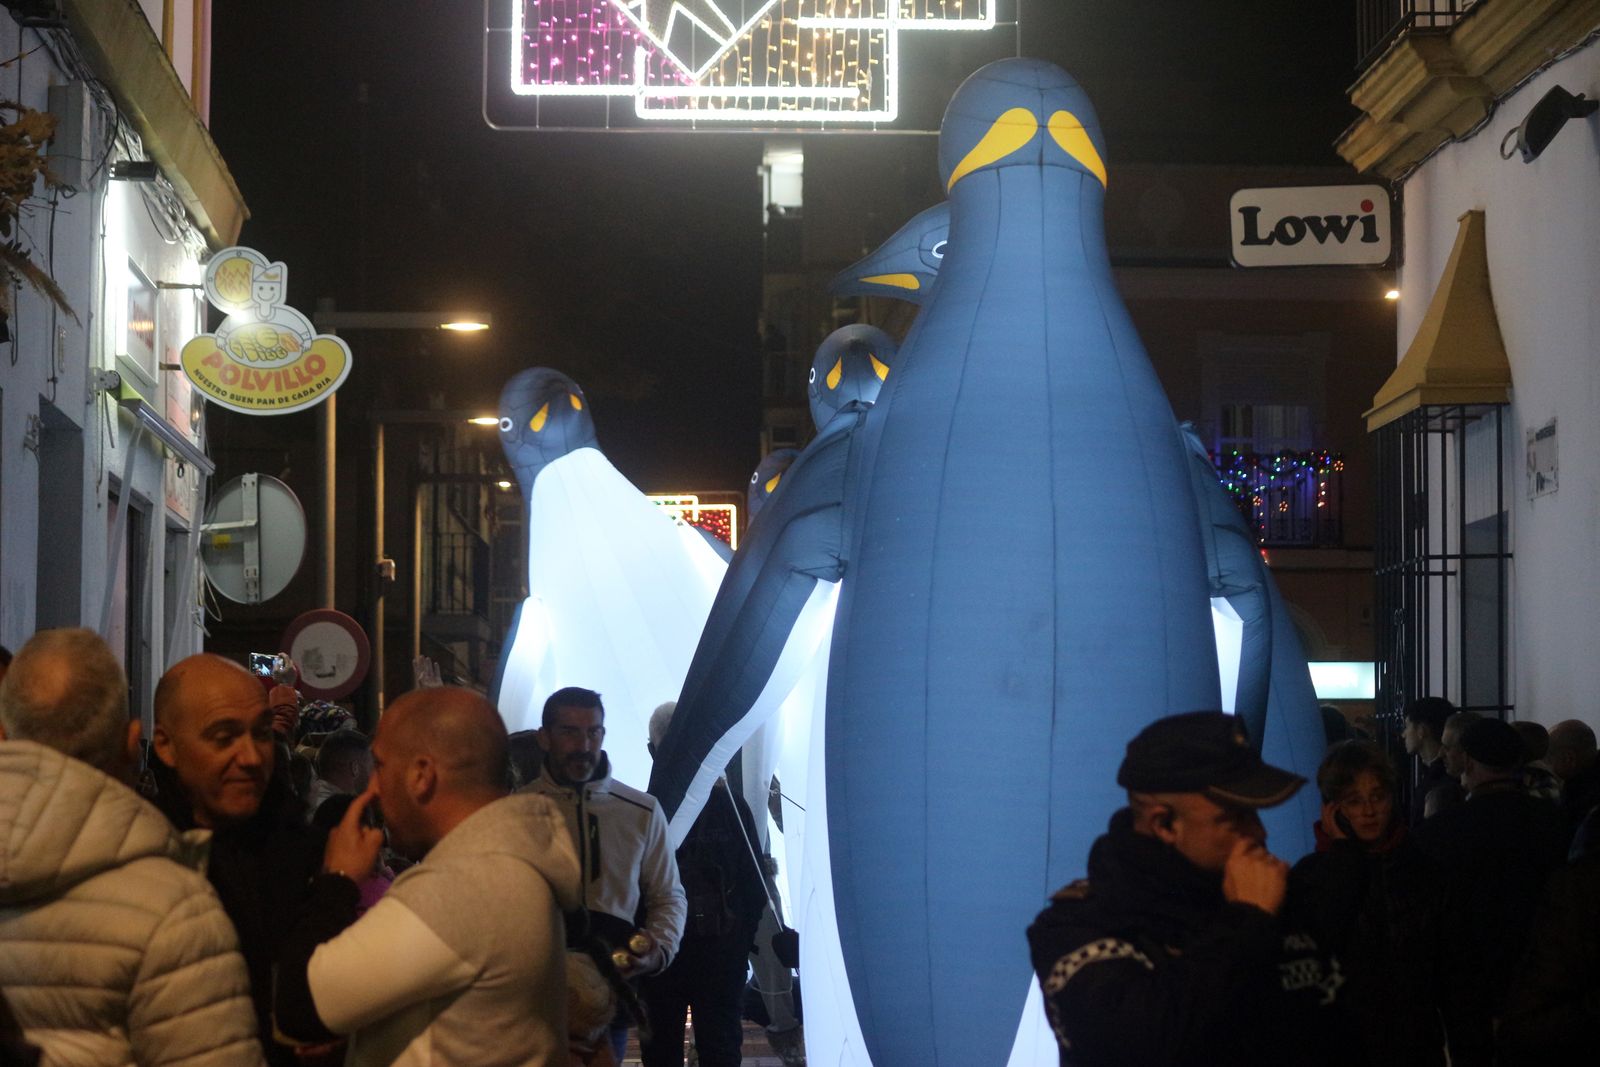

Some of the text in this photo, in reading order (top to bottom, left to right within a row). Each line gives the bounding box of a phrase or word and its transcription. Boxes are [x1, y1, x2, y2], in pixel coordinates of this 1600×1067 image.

[1238, 199, 1380, 245] Lowi
[194, 369, 331, 405] NUESTRO BUEN PAN DE CADA DIA
[201, 351, 326, 392] POLVILLO
